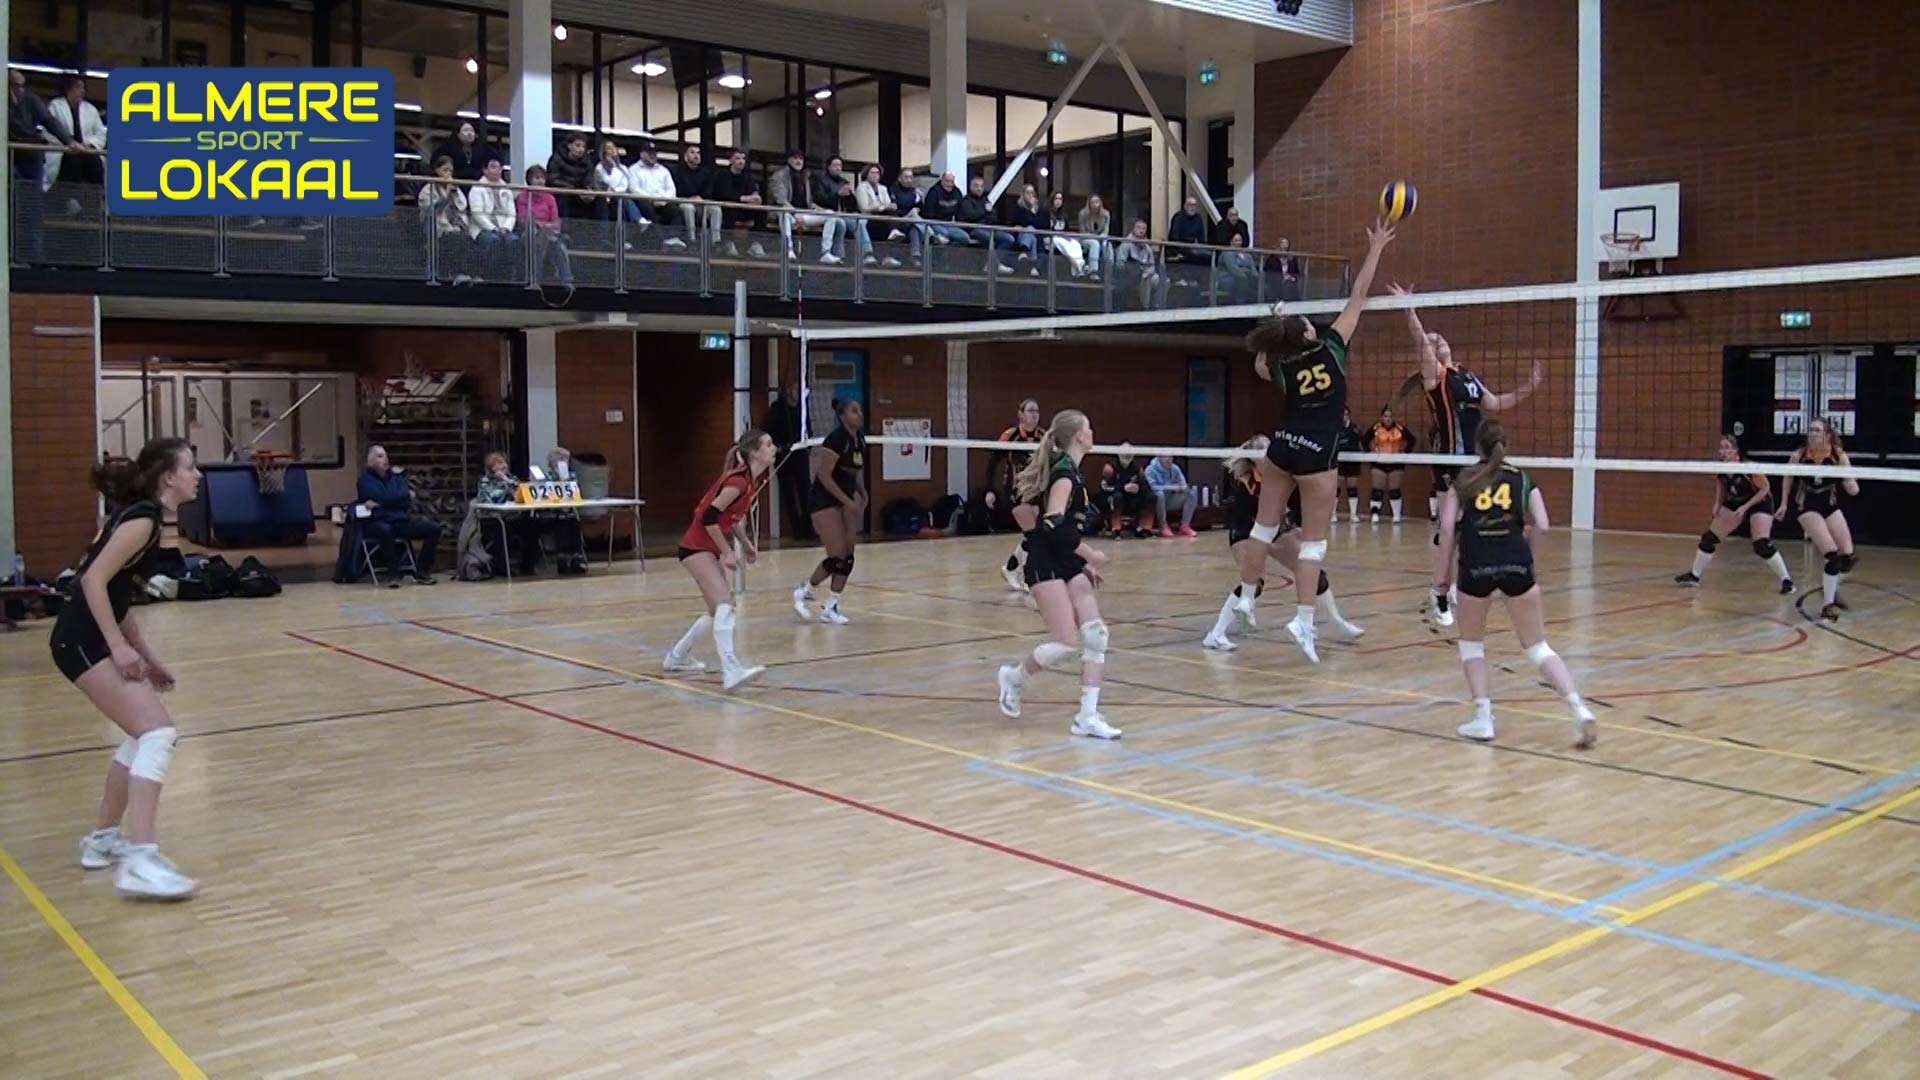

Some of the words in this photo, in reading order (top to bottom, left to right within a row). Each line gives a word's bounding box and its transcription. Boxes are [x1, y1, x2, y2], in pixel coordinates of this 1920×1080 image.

[1296, 363, 1332, 396] 25
[529, 485, 549, 500] 02
[554, 485, 573, 499] 05
[1474, 483, 1513, 510] 84
